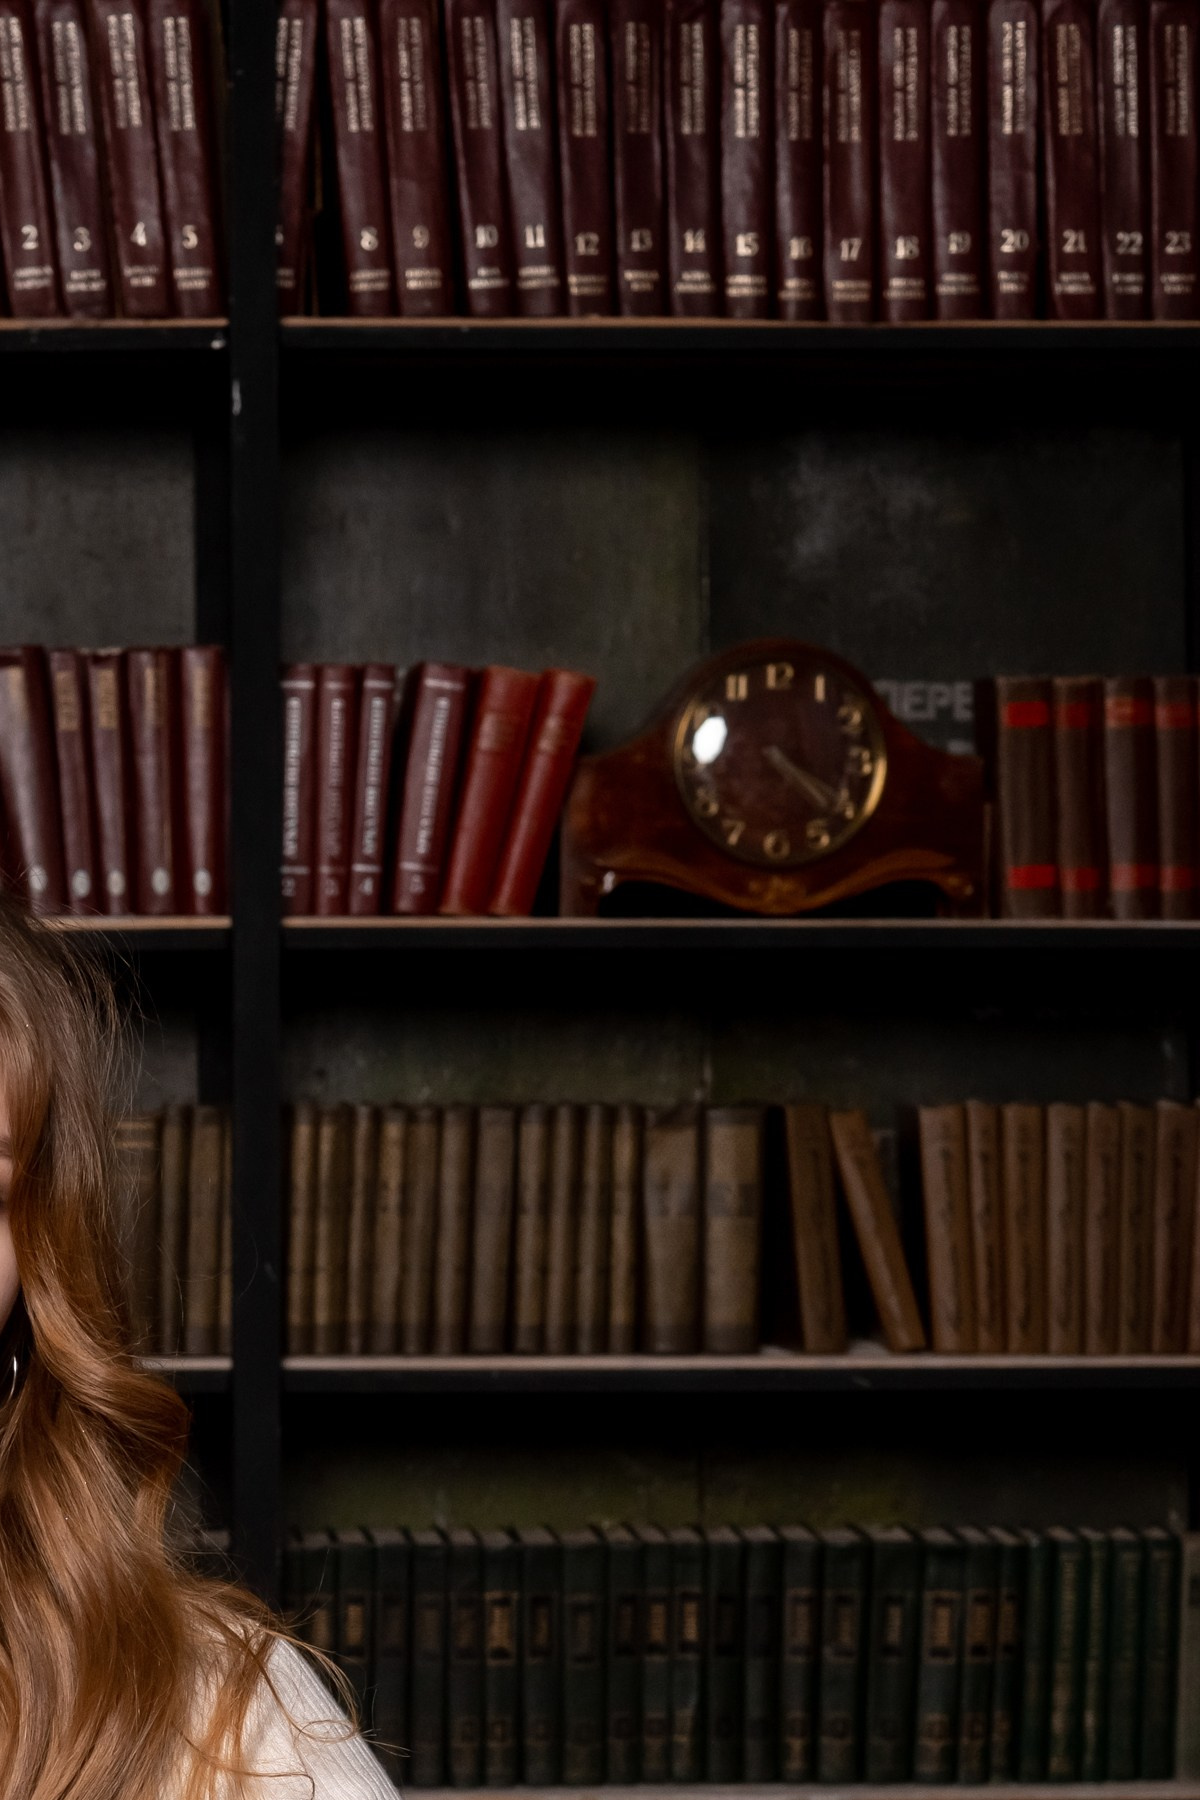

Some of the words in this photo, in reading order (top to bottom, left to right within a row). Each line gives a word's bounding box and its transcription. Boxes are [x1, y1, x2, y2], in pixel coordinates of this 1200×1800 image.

[20, 224, 39, 251] 2
[73, 226, 92, 252] 3
[130, 221, 147, 247] 4
[182, 224, 199, 250] 5
[359, 225, 379, 252] 8
[411, 224, 430, 250] 9
[475, 223, 499, 250] 10
[524, 223, 546, 249] 11
[574, 231, 600, 257] 12
[630, 228, 653, 253] 13
[683, 228, 706, 253] 14
[735, 232, 759, 257] 15
[947, 231, 971, 255] 19
[999, 228, 1029, 254] 20
[1061, 229, 1087, 254] 21
[1115, 231, 1143, 255] 22
[1164, 231, 1192, 255] 23
[839, 236, 863, 262] 17
[894, 235, 920, 261] 18
[725, 673, 749, 701] 11
[765, 662, 794, 690] 12
[814, 673, 826, 702] 1
[838, 705, 863, 734] 2
[849, 746, 872, 776] 3
[722, 819, 746, 846] 7
[763, 830, 790, 860] 6
[806, 820, 831, 850] 5
